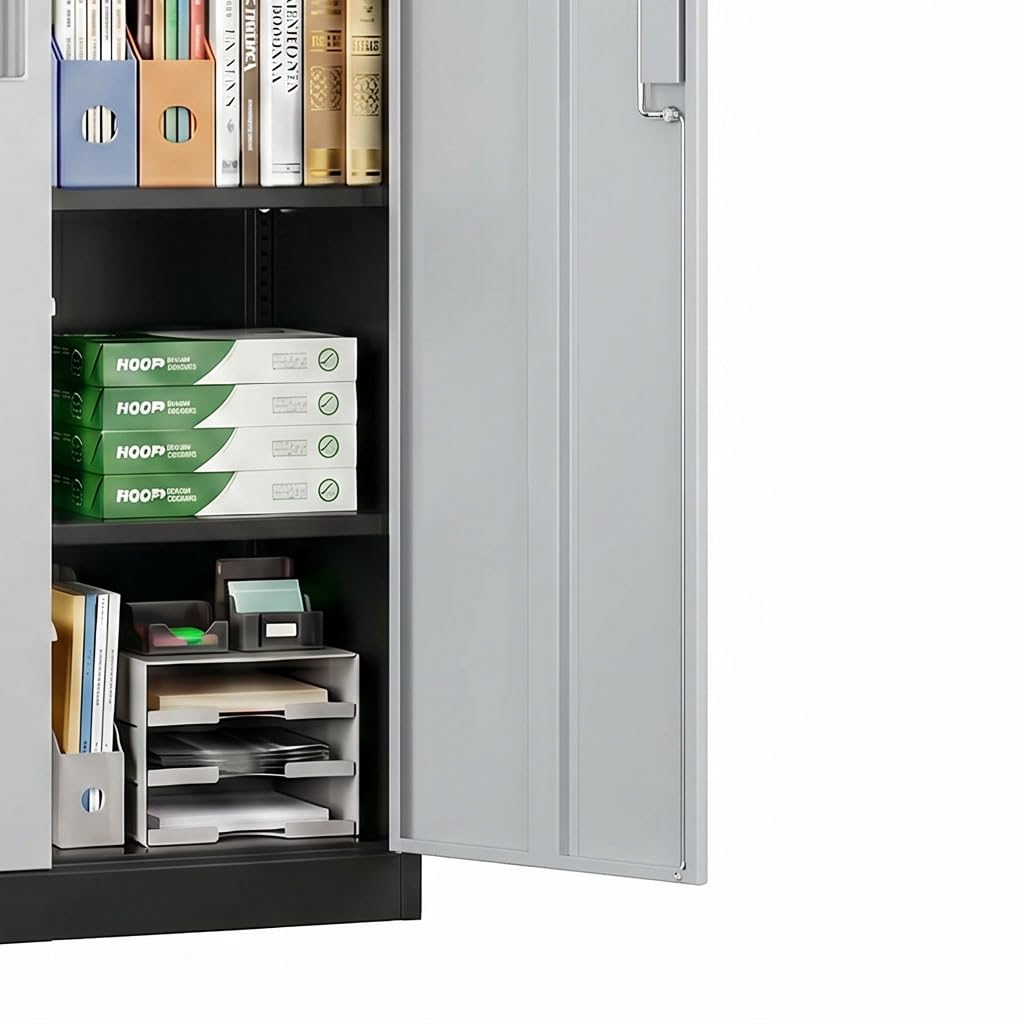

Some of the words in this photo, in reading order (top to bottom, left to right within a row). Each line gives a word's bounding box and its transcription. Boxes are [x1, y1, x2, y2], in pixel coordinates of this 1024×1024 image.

[116, 357, 166, 372] HOOP
[116, 400, 166, 416] HOOP
[116, 444, 166, 460] HOOP
